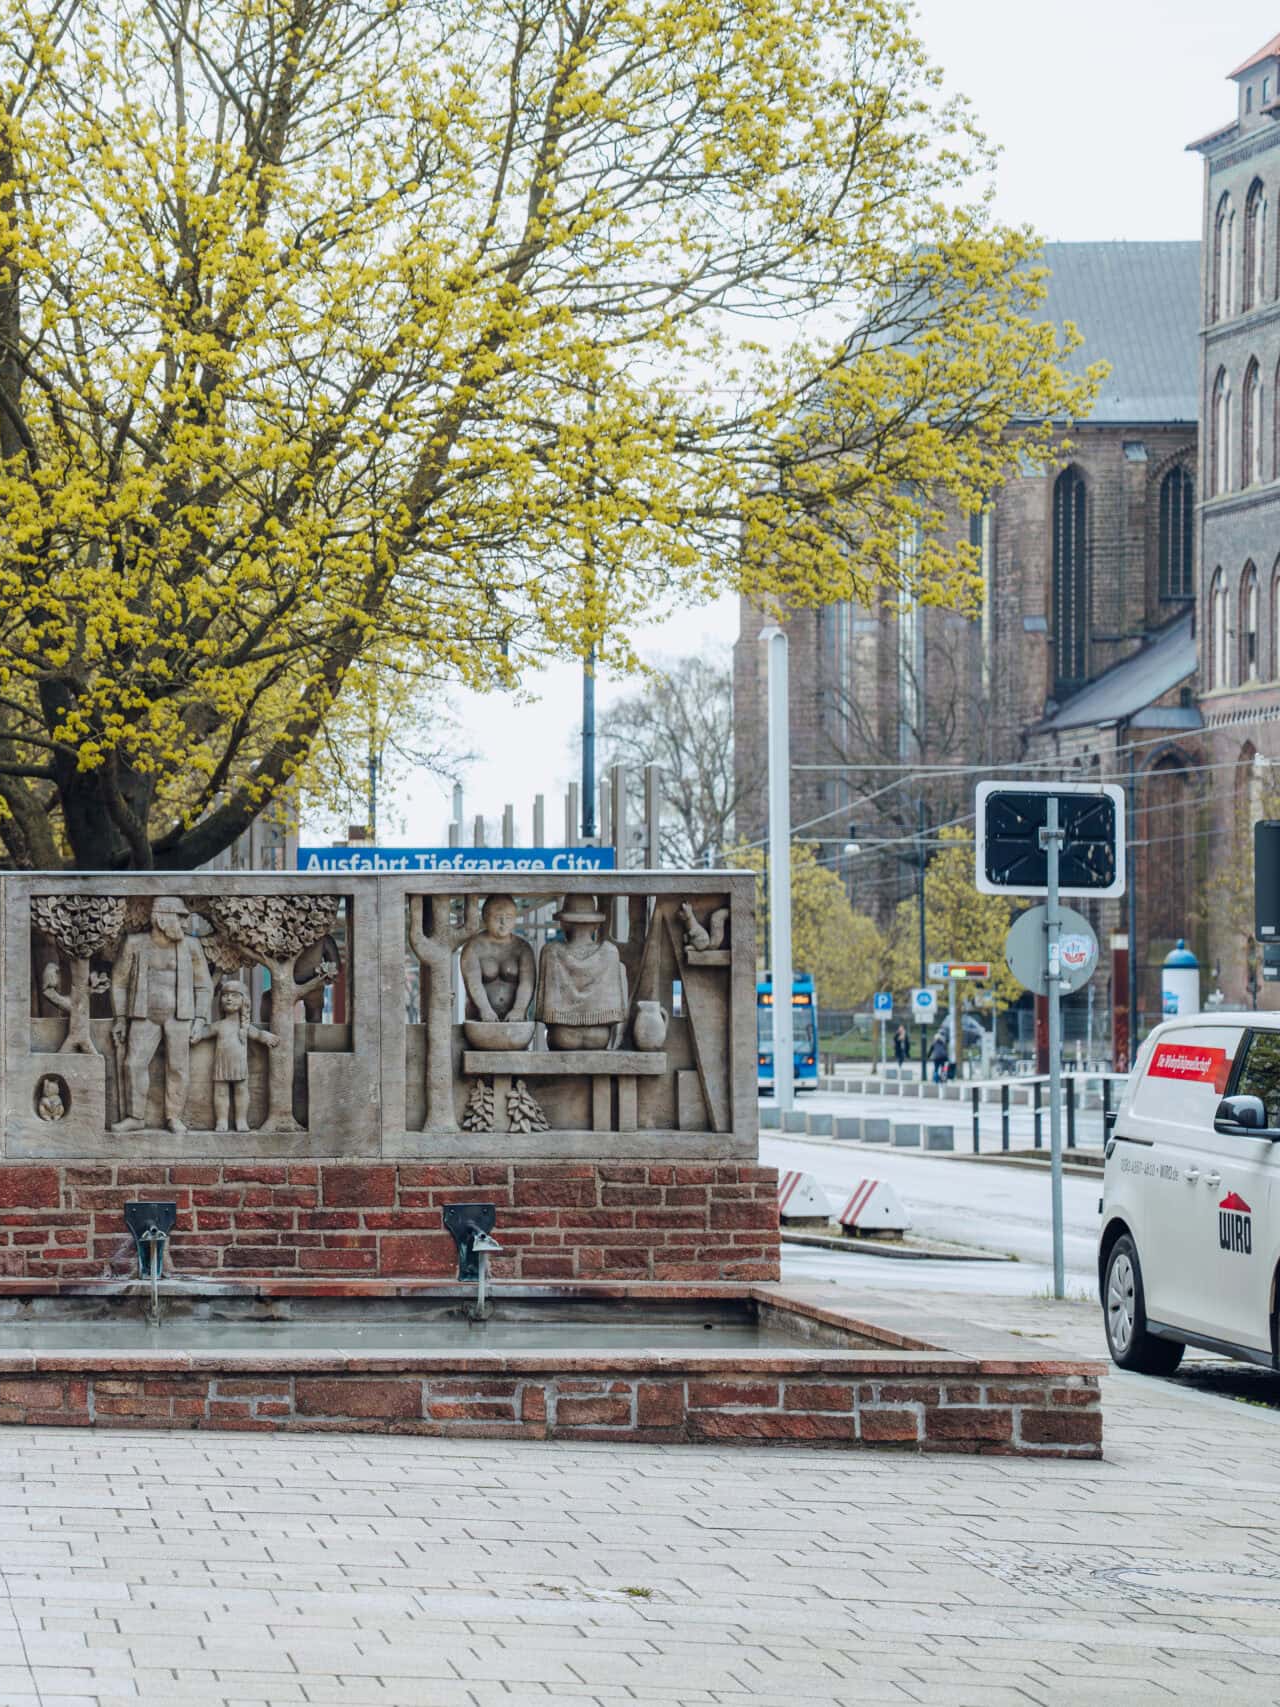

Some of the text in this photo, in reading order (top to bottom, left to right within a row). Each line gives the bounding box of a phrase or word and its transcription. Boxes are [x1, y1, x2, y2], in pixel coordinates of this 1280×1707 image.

[306, 853, 601, 871] Ausfahrt Tiefgarage City
[878, 994, 889, 1008] P
[1219, 1211, 1252, 1255] WIRO
